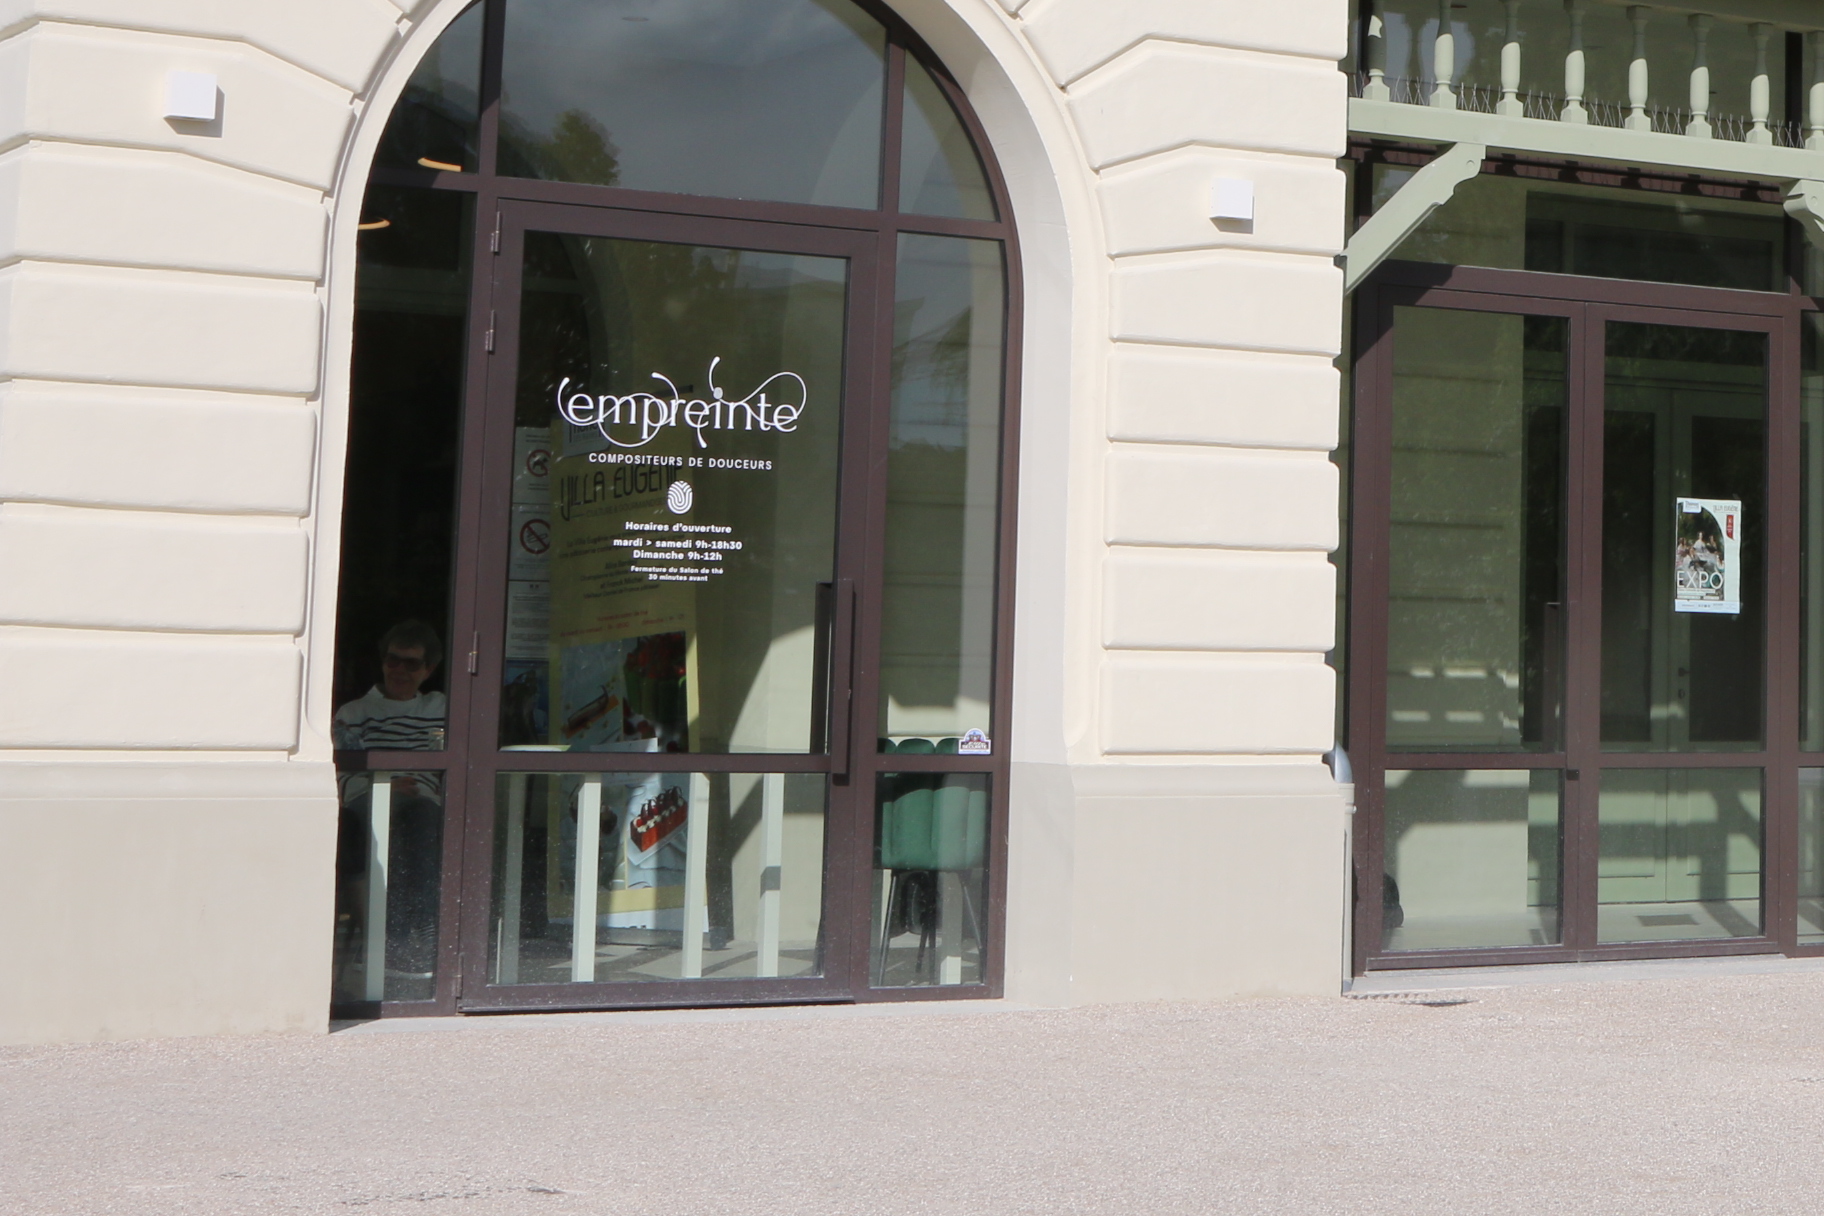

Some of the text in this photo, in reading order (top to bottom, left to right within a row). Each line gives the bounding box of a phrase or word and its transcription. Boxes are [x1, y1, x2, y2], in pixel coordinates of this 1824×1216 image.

[588, 452, 773, 471] COMPOSITEURS DE DOUCEURS
[625, 521, 670, 532] Horaires
[613, 538, 643, 547] mardi
[655, 539, 693, 549] samedi
[695, 540, 743, 550] 9h-18h30
[633, 549, 723, 561] Dimanche 9h-12h
[630, 565, 667, 573] Fermeture
[668, 566, 678, 574] du
[679, 566, 699, 574] Salon
[648, 573, 658, 581] 30
[659, 573, 688, 581] minutes
[1677, 570, 1724, 590] EXPO
